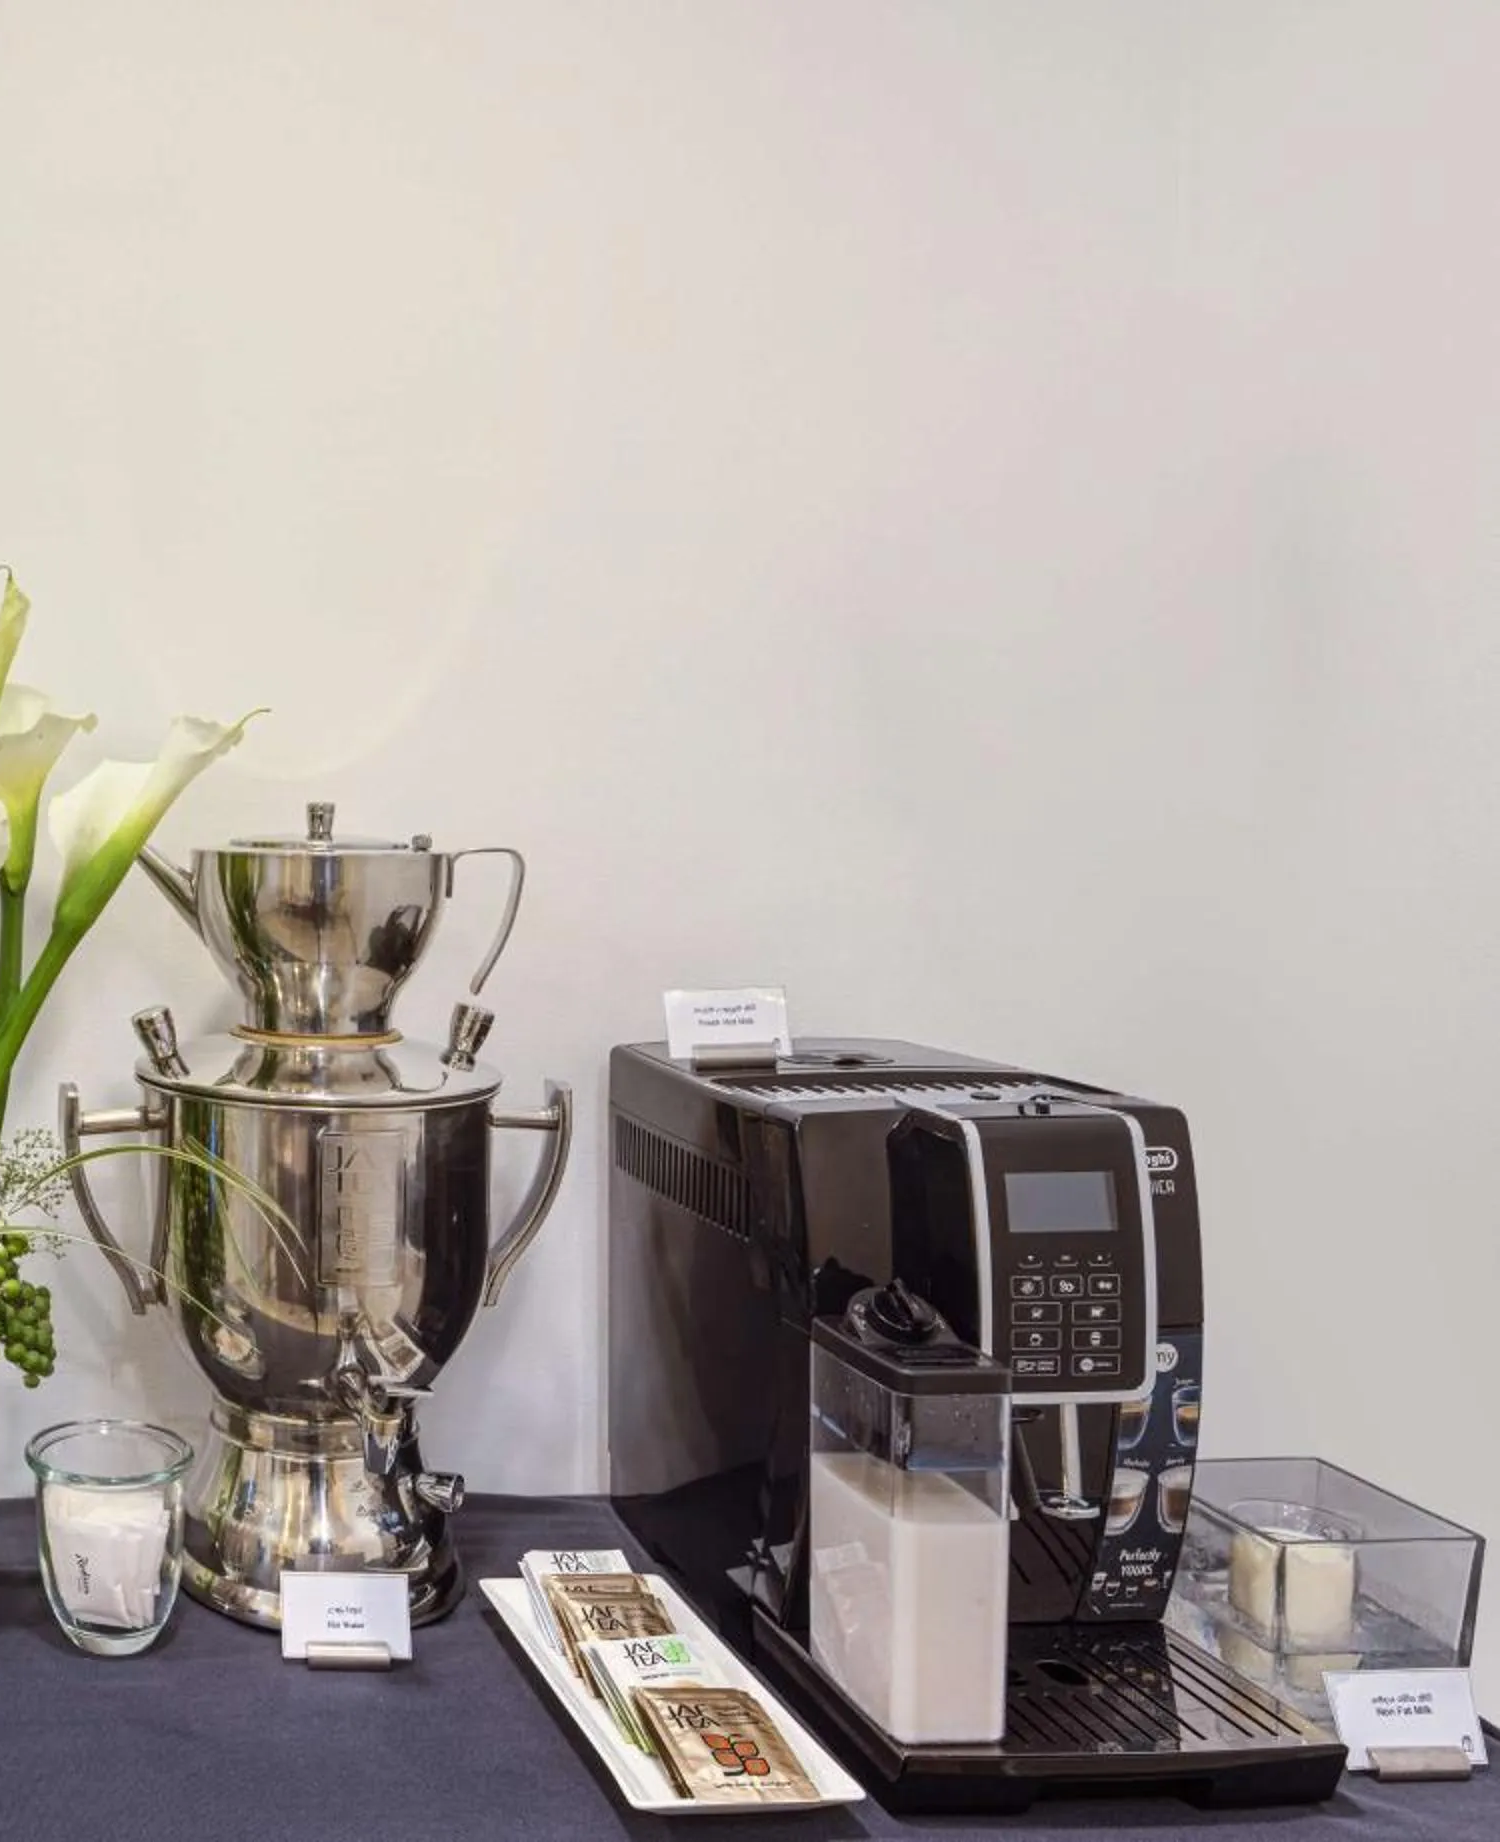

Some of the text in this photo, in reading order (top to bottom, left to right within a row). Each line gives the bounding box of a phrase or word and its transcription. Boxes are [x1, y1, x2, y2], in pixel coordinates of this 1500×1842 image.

[581, 1605, 617, 1623] JAF
[585, 1617, 629, 1631] TEA
[623, 1641, 657, 1658] JAF
[629, 1651, 668, 1667] TEA
[667, 1703, 706, 1720] JAF
[1413, 1704, 1433, 1715] Milk
[674, 1714, 721, 1729] TEA
